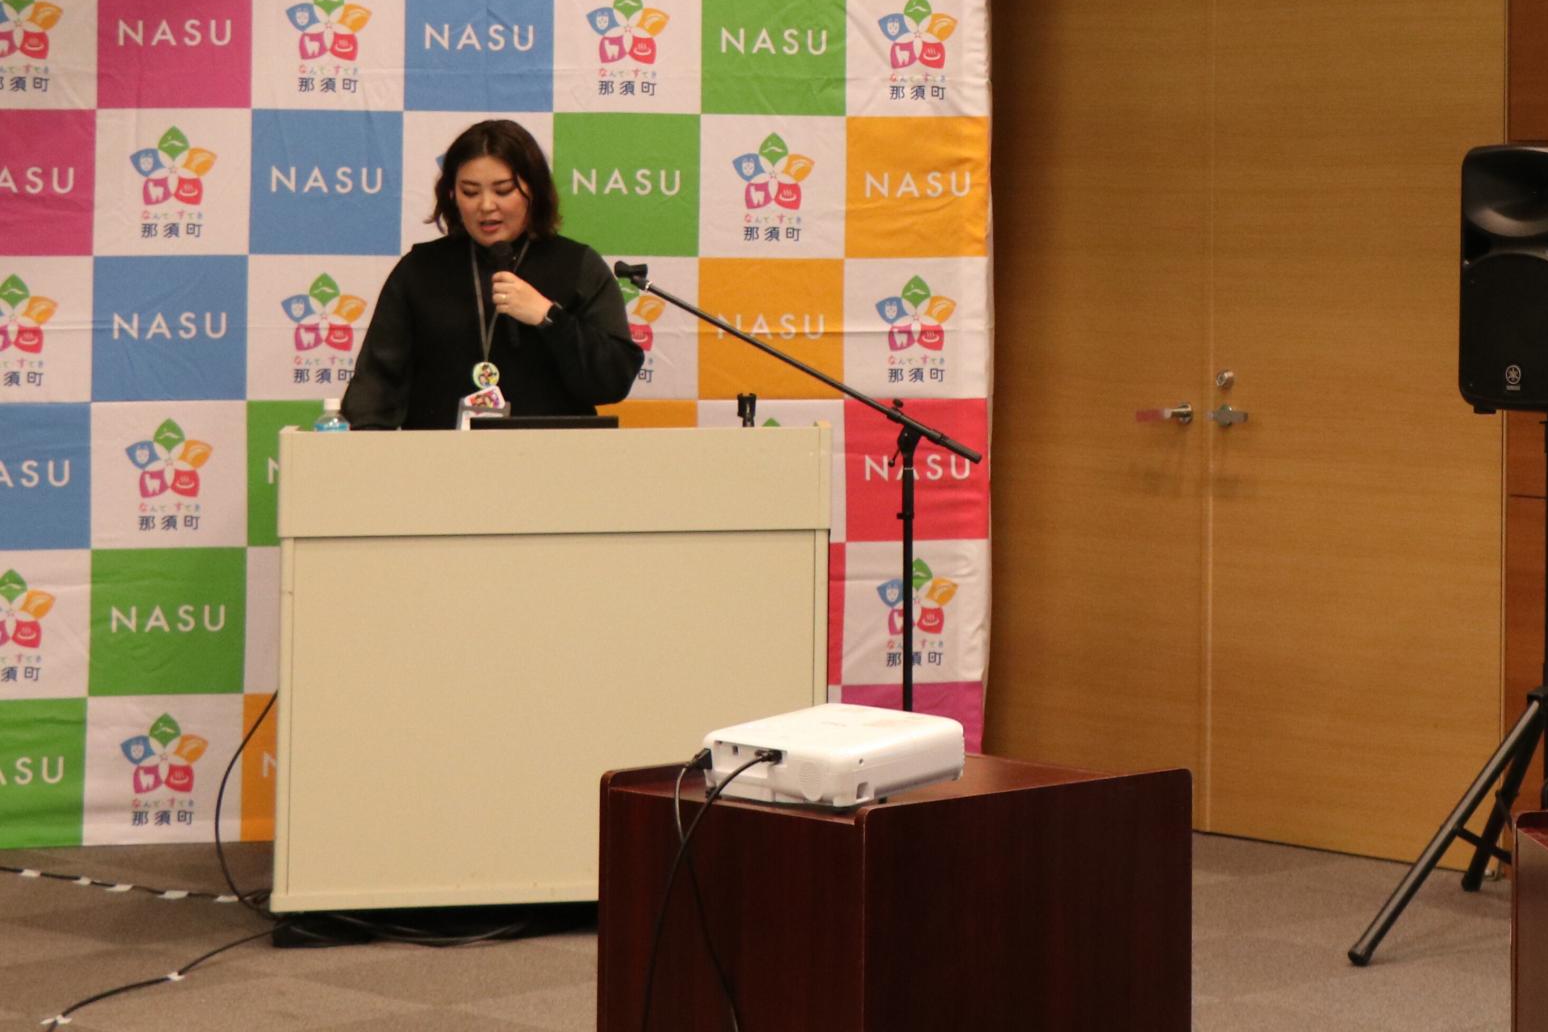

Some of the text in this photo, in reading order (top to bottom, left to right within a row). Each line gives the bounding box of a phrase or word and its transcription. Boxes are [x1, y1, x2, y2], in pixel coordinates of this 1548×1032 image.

[118, 19, 231, 46] NASU
[424, 23, 534, 51] NASU
[720, 28, 826, 55] NASU
[299, 77, 357, 93] 那須町
[599, 81, 656, 96] 那須町
[890, 85, 945, 100] 那須町
[271, 166, 382, 194] NASU
[572, 168, 680, 195] NASU
[865, 171, 971, 197] NASU
[142, 223, 202, 238] 那須町
[744, 227, 801, 241] 那須町
[113, 312, 226, 339] NASU
[889, 368, 944, 382] 那須町
[140, 515, 200, 530] 那須町
[110, 605, 224, 632] NASU
[133, 810, 193, 825] 那須町
